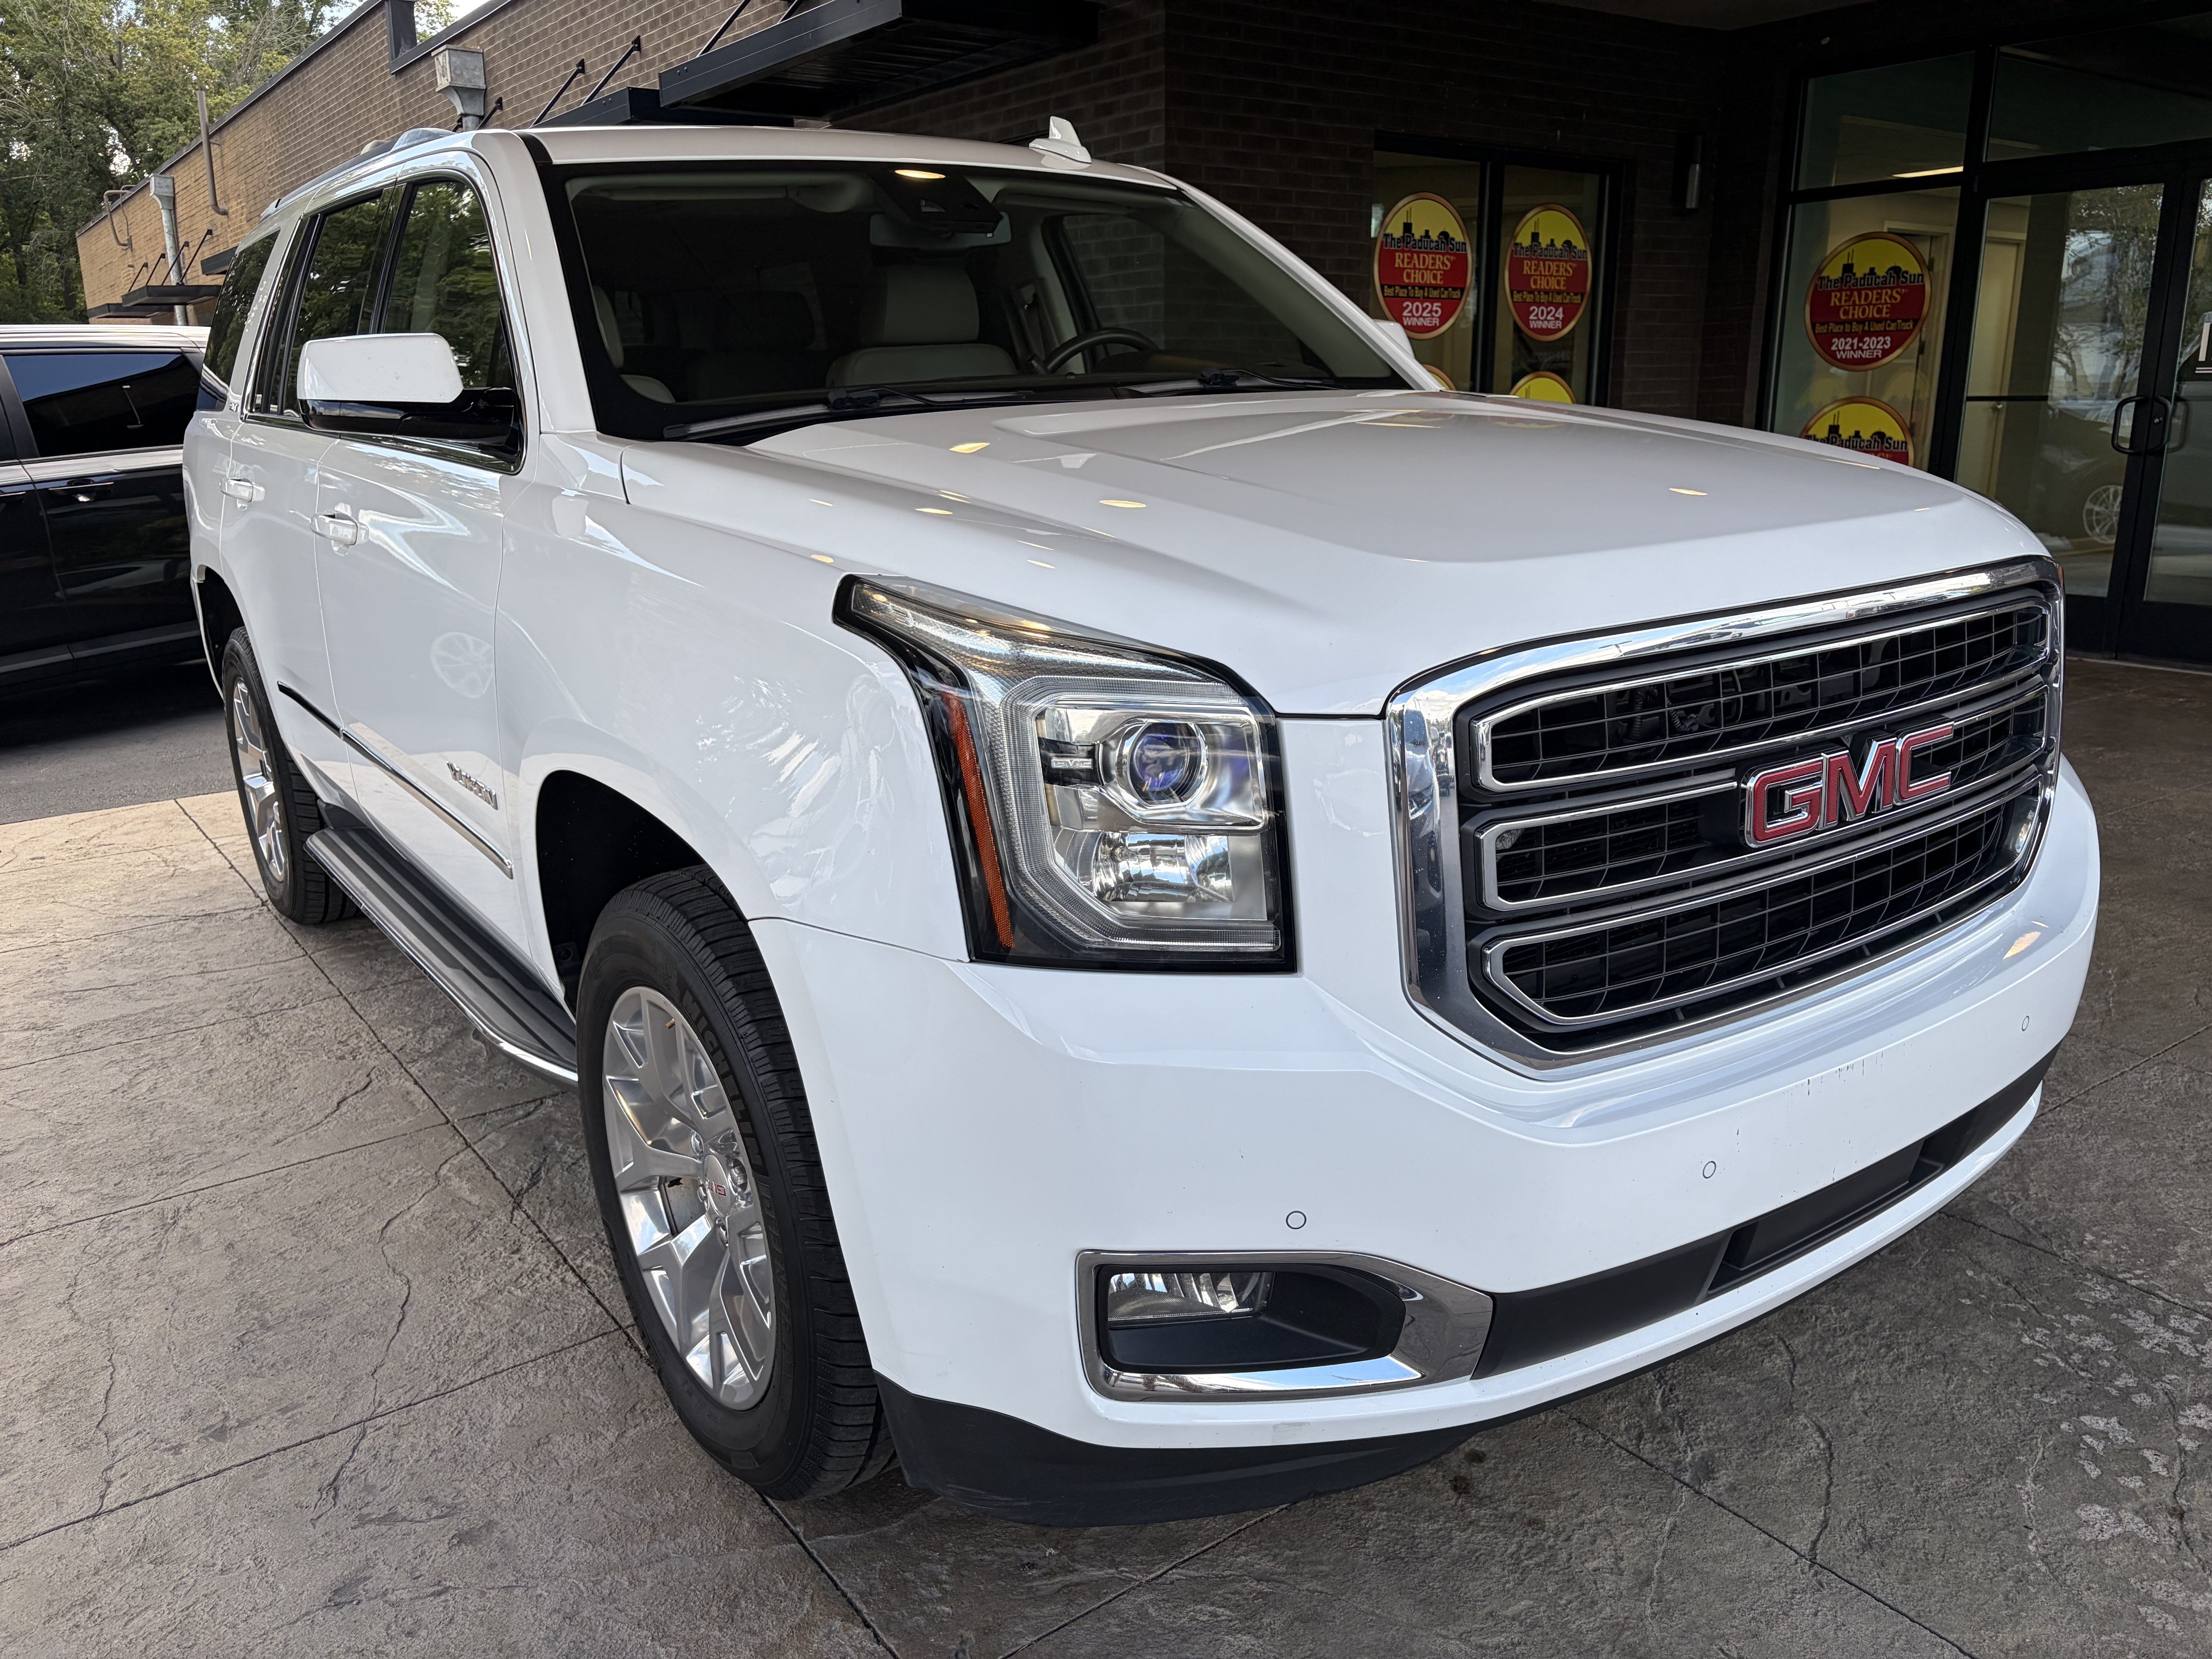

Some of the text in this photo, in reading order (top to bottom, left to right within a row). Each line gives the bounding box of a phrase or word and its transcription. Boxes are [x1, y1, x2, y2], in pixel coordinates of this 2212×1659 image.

[1384, 233, 1467, 254] The Paducah Sun
[1513, 242, 1588, 261] The Paducah Sun
[1403, 269, 1444, 284] CHOICE
[1530, 275, 1566, 290] CHOICE
[1817, 270, 1925, 291] The Paducah Sun
[1384, 285, 1394, 296] Best
[1395, 286, 1408, 297] Place
[1415, 287, 1423, 299] Buy
[1424, 287, 1428, 297] A
[1429, 287, 1440, 298] Used
[1402, 302, 1442, 317] 2025
[1529, 306, 1564, 320] 2024
[1839, 304, 1891, 319] CHOICE
[1402, 317, 1439, 327] WINNER
[1529, 320, 1562, 329] WINNER
[1815, 323, 1827, 333] Best
[1828, 323, 1844, 333] Place
[1852, 321, 1862, 334] Buy
[1864, 321, 1869, 331] A
[1870, 320, 1885, 331] Used
[1831, 336, 1891, 350] 2021-2023
[1836, 349, 1882, 359] WINNER
[1883, 436, 1908, 452] Sun
[1744, 721, 1954, 848] GMC
[682, 989, 763, 1166] MICHELIN
